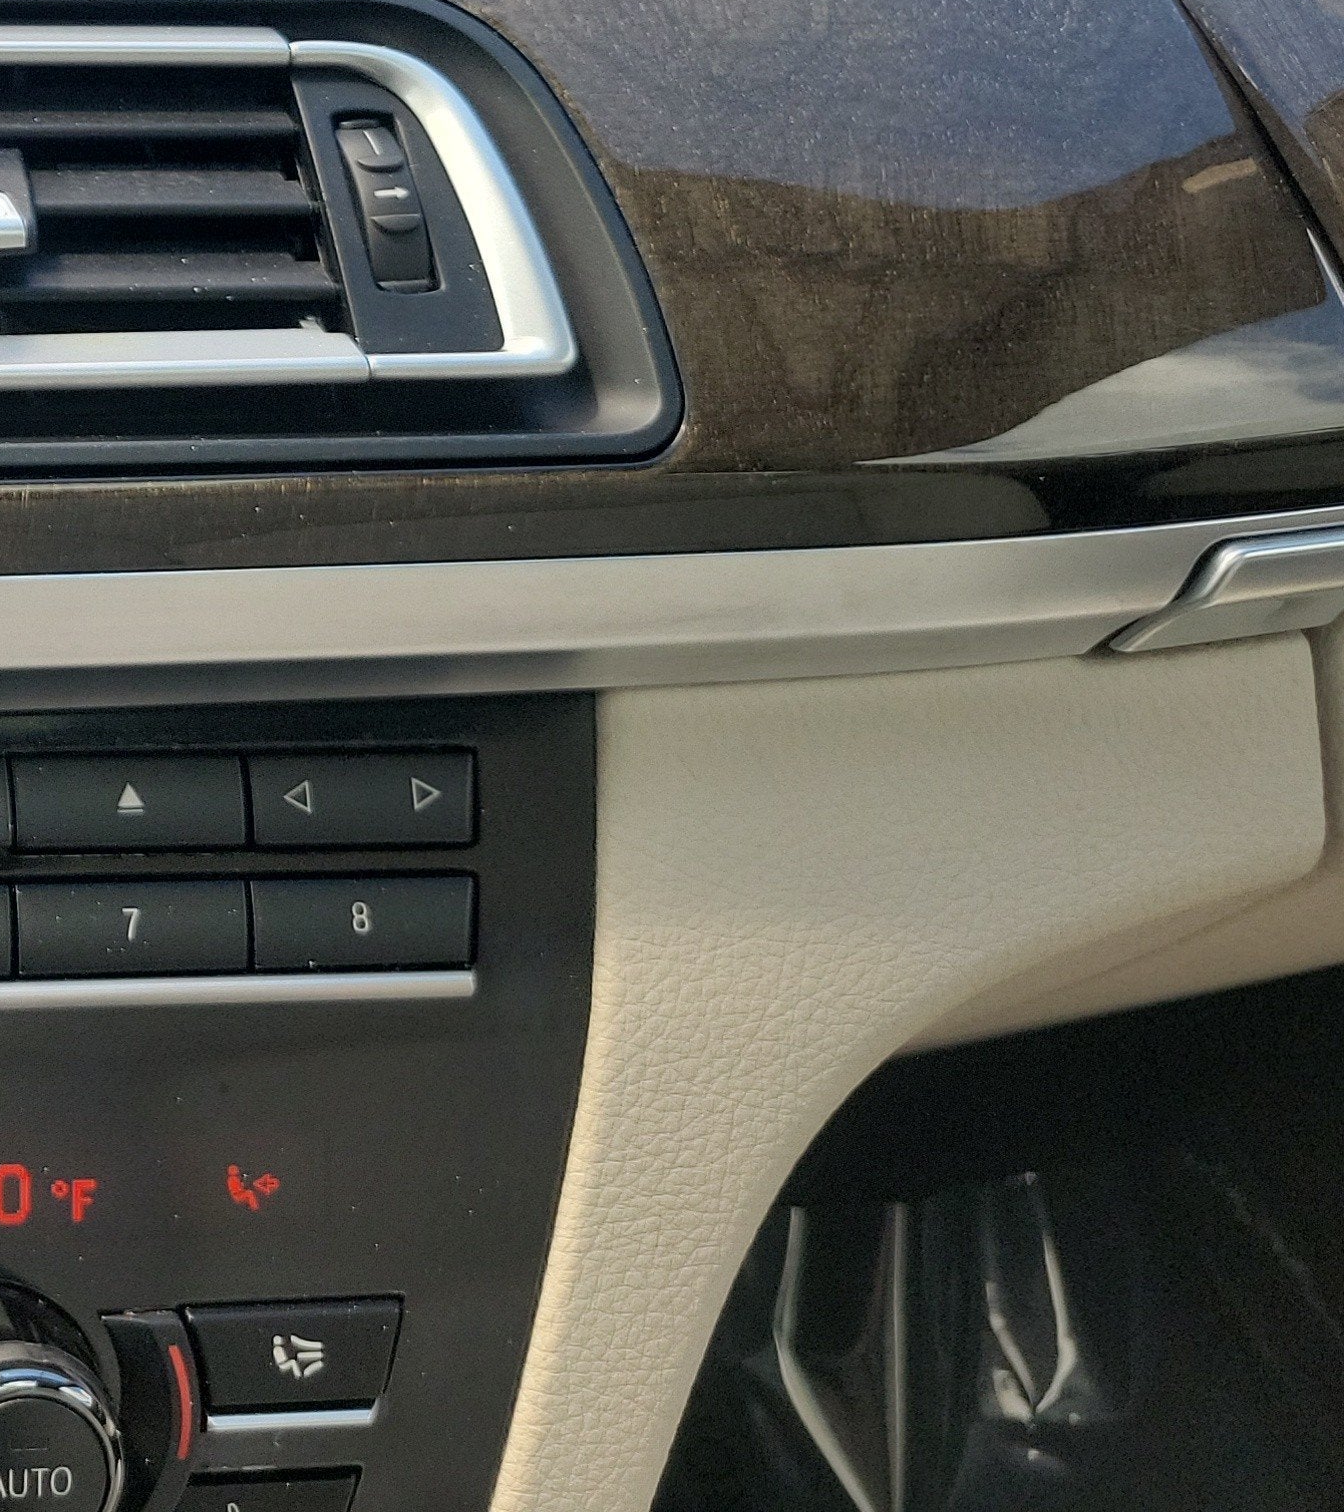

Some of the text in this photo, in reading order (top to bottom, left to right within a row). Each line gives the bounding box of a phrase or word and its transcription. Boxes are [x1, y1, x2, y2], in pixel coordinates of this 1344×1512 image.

[122, 907, 141, 941] 7
[351, 901, 372, 934] 8
[50, 1178, 98, 1223] °F
